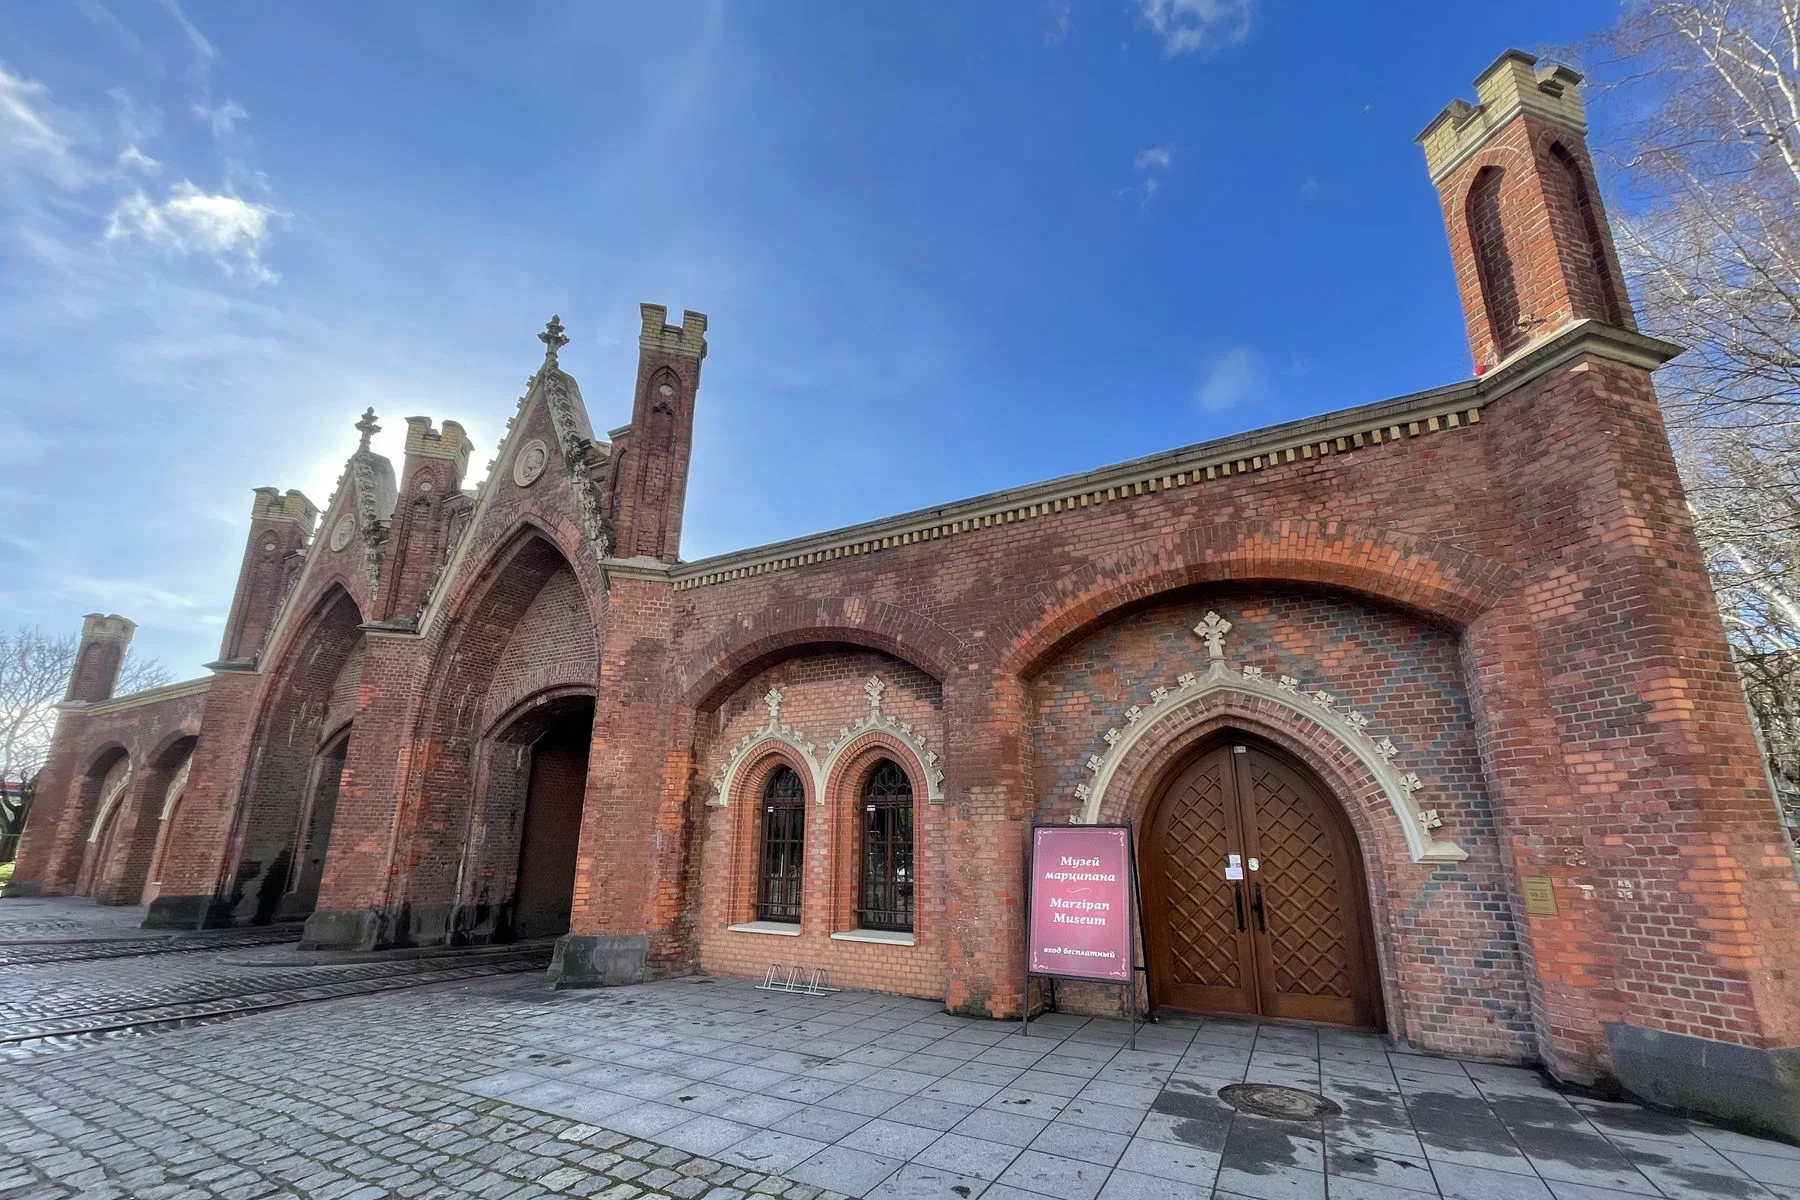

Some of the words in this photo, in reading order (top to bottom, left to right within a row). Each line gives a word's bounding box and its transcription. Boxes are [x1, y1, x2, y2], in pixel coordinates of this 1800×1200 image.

[1060, 855, 1101, 869] Музей
[1045, 871, 1116, 883] марципана
[1049, 897, 1110, 912] Marzipan
[1053, 912, 1106, 926] Museum
[1043, 946, 1062, 954] вход
[1063, 947, 1116, 959] бесплатный
